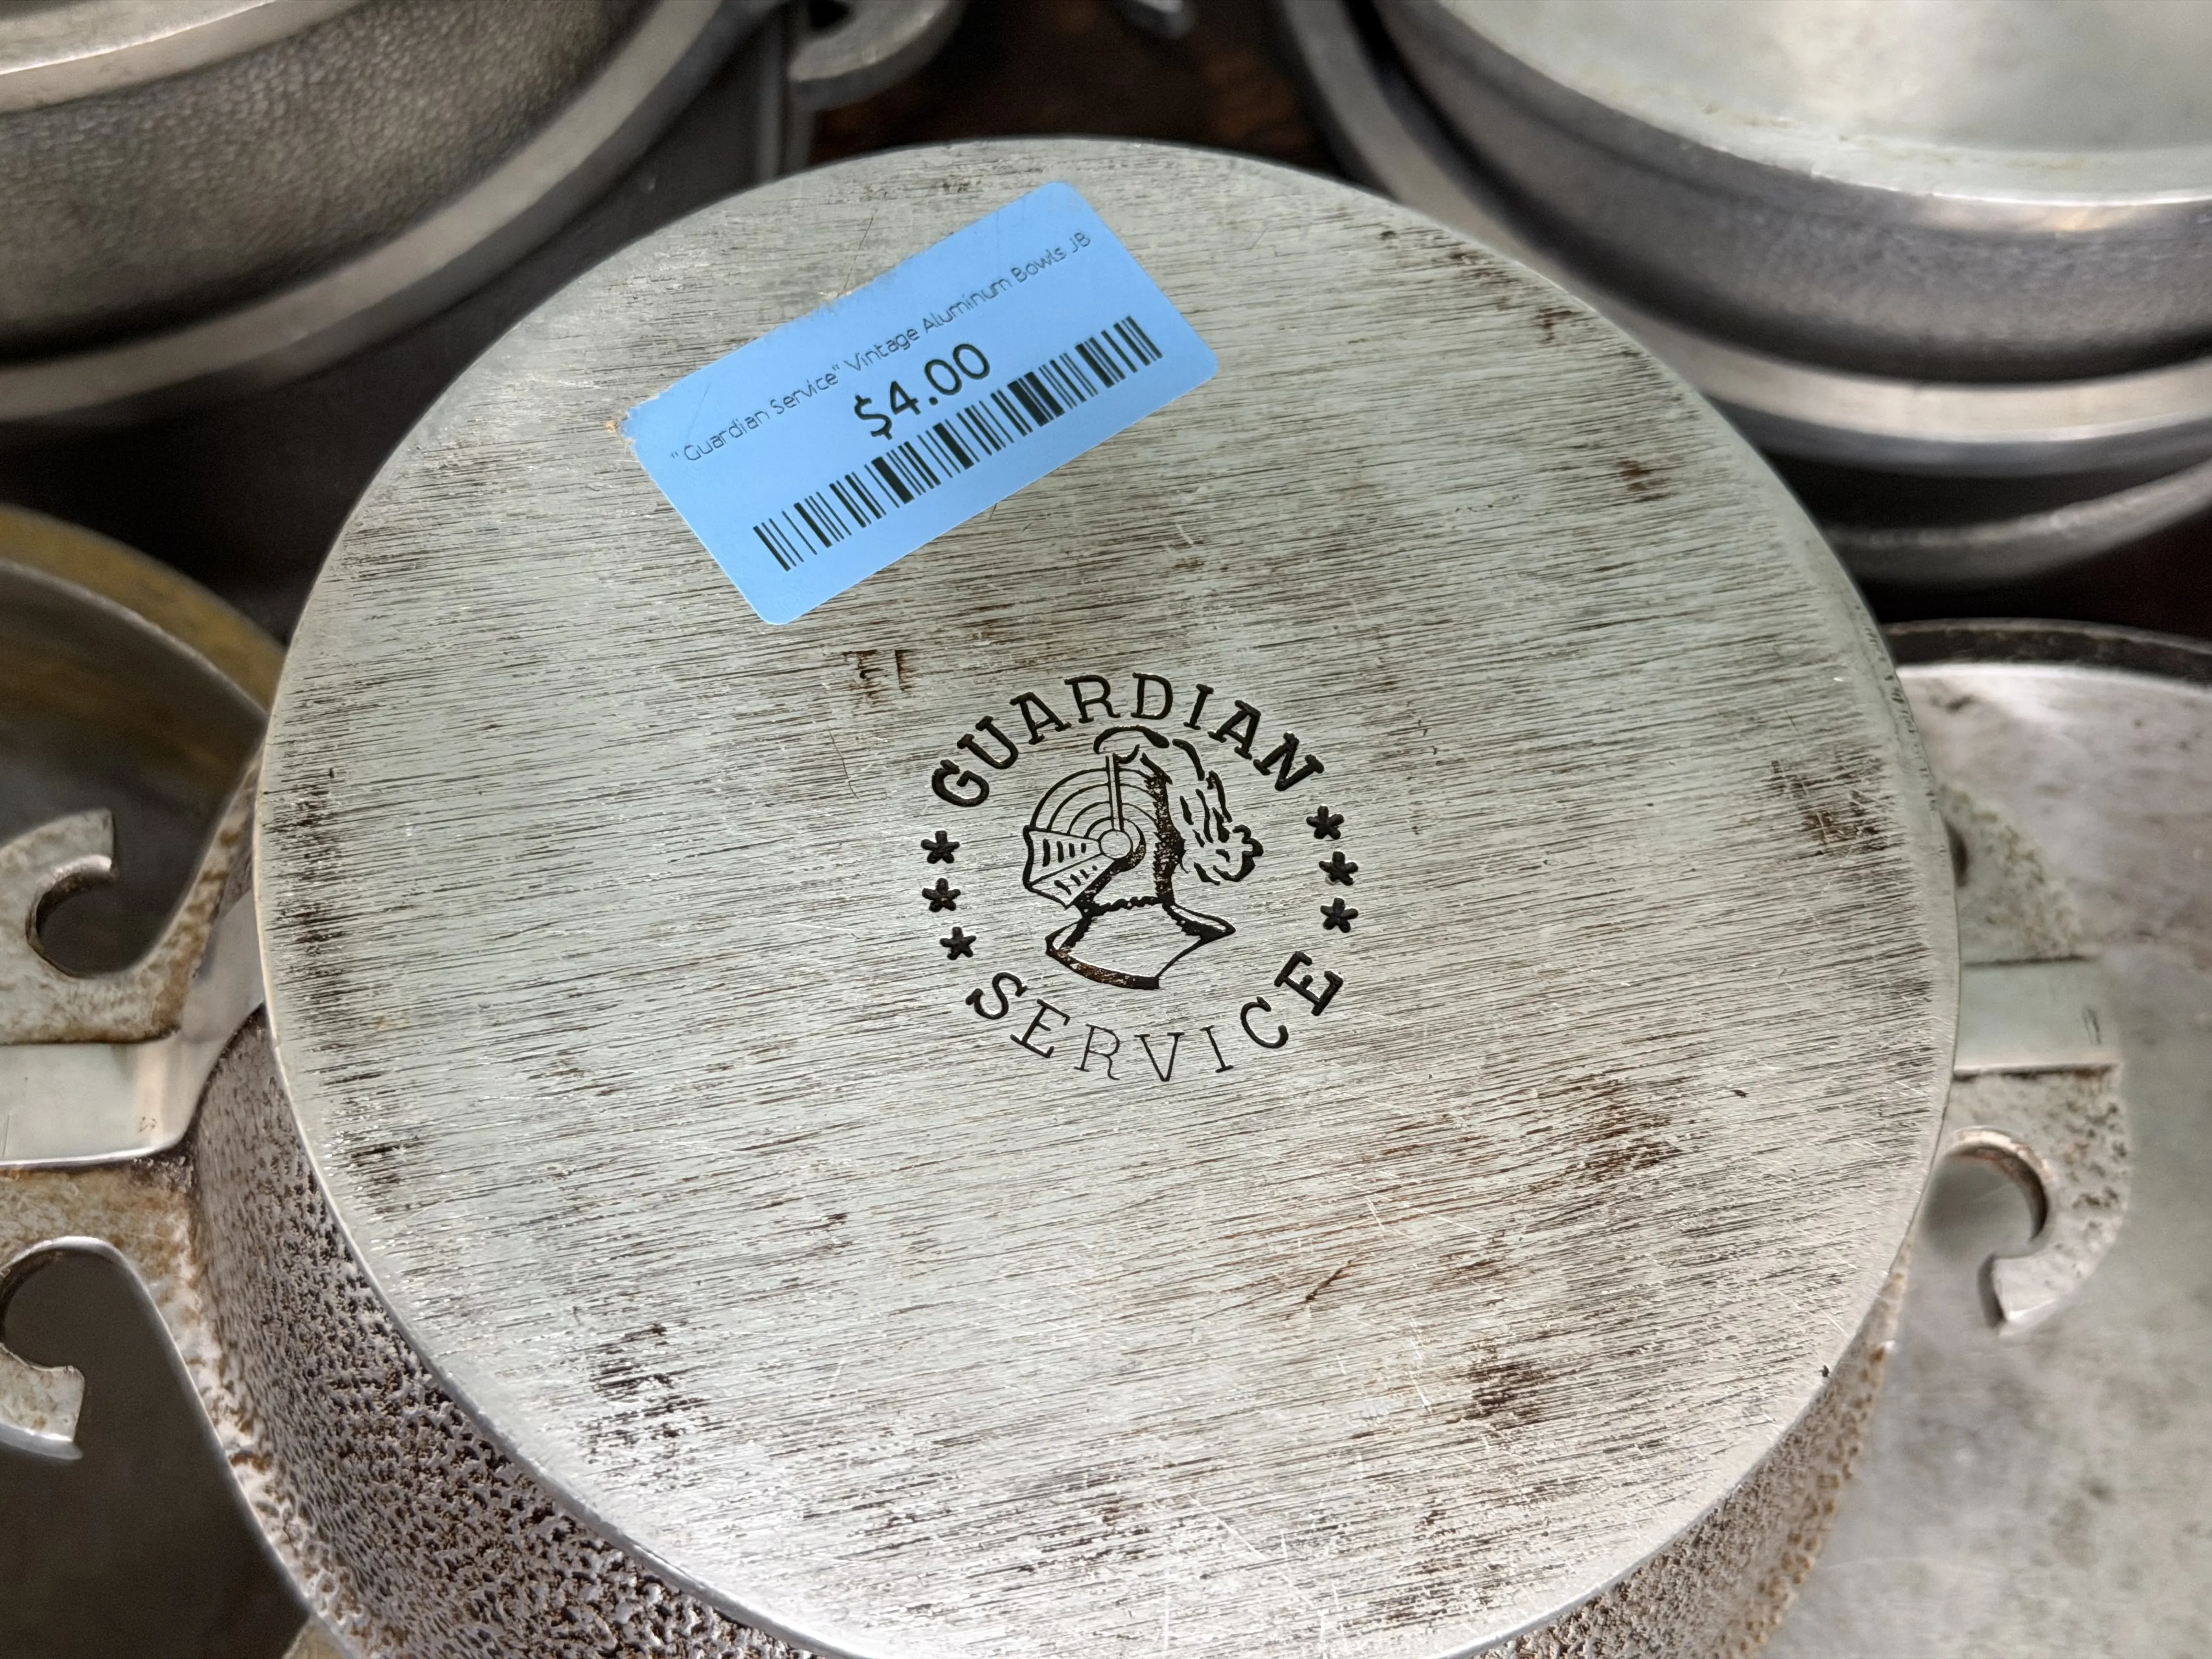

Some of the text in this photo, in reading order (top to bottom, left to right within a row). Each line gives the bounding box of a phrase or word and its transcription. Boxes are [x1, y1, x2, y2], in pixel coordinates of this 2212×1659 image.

[770, 364, 840, 415] Service"
[844, 329, 921, 371] Vintage
[922, 278, 1013, 334] Aluminum
[1010, 247, 1067, 283] Bowls
[1069, 232, 1091, 253] JB
[854, 343, 990, 439] $4.00
[932, 672, 1324, 807] GUARDIAN
[966, 951, 1344, 1082] SERVICE
